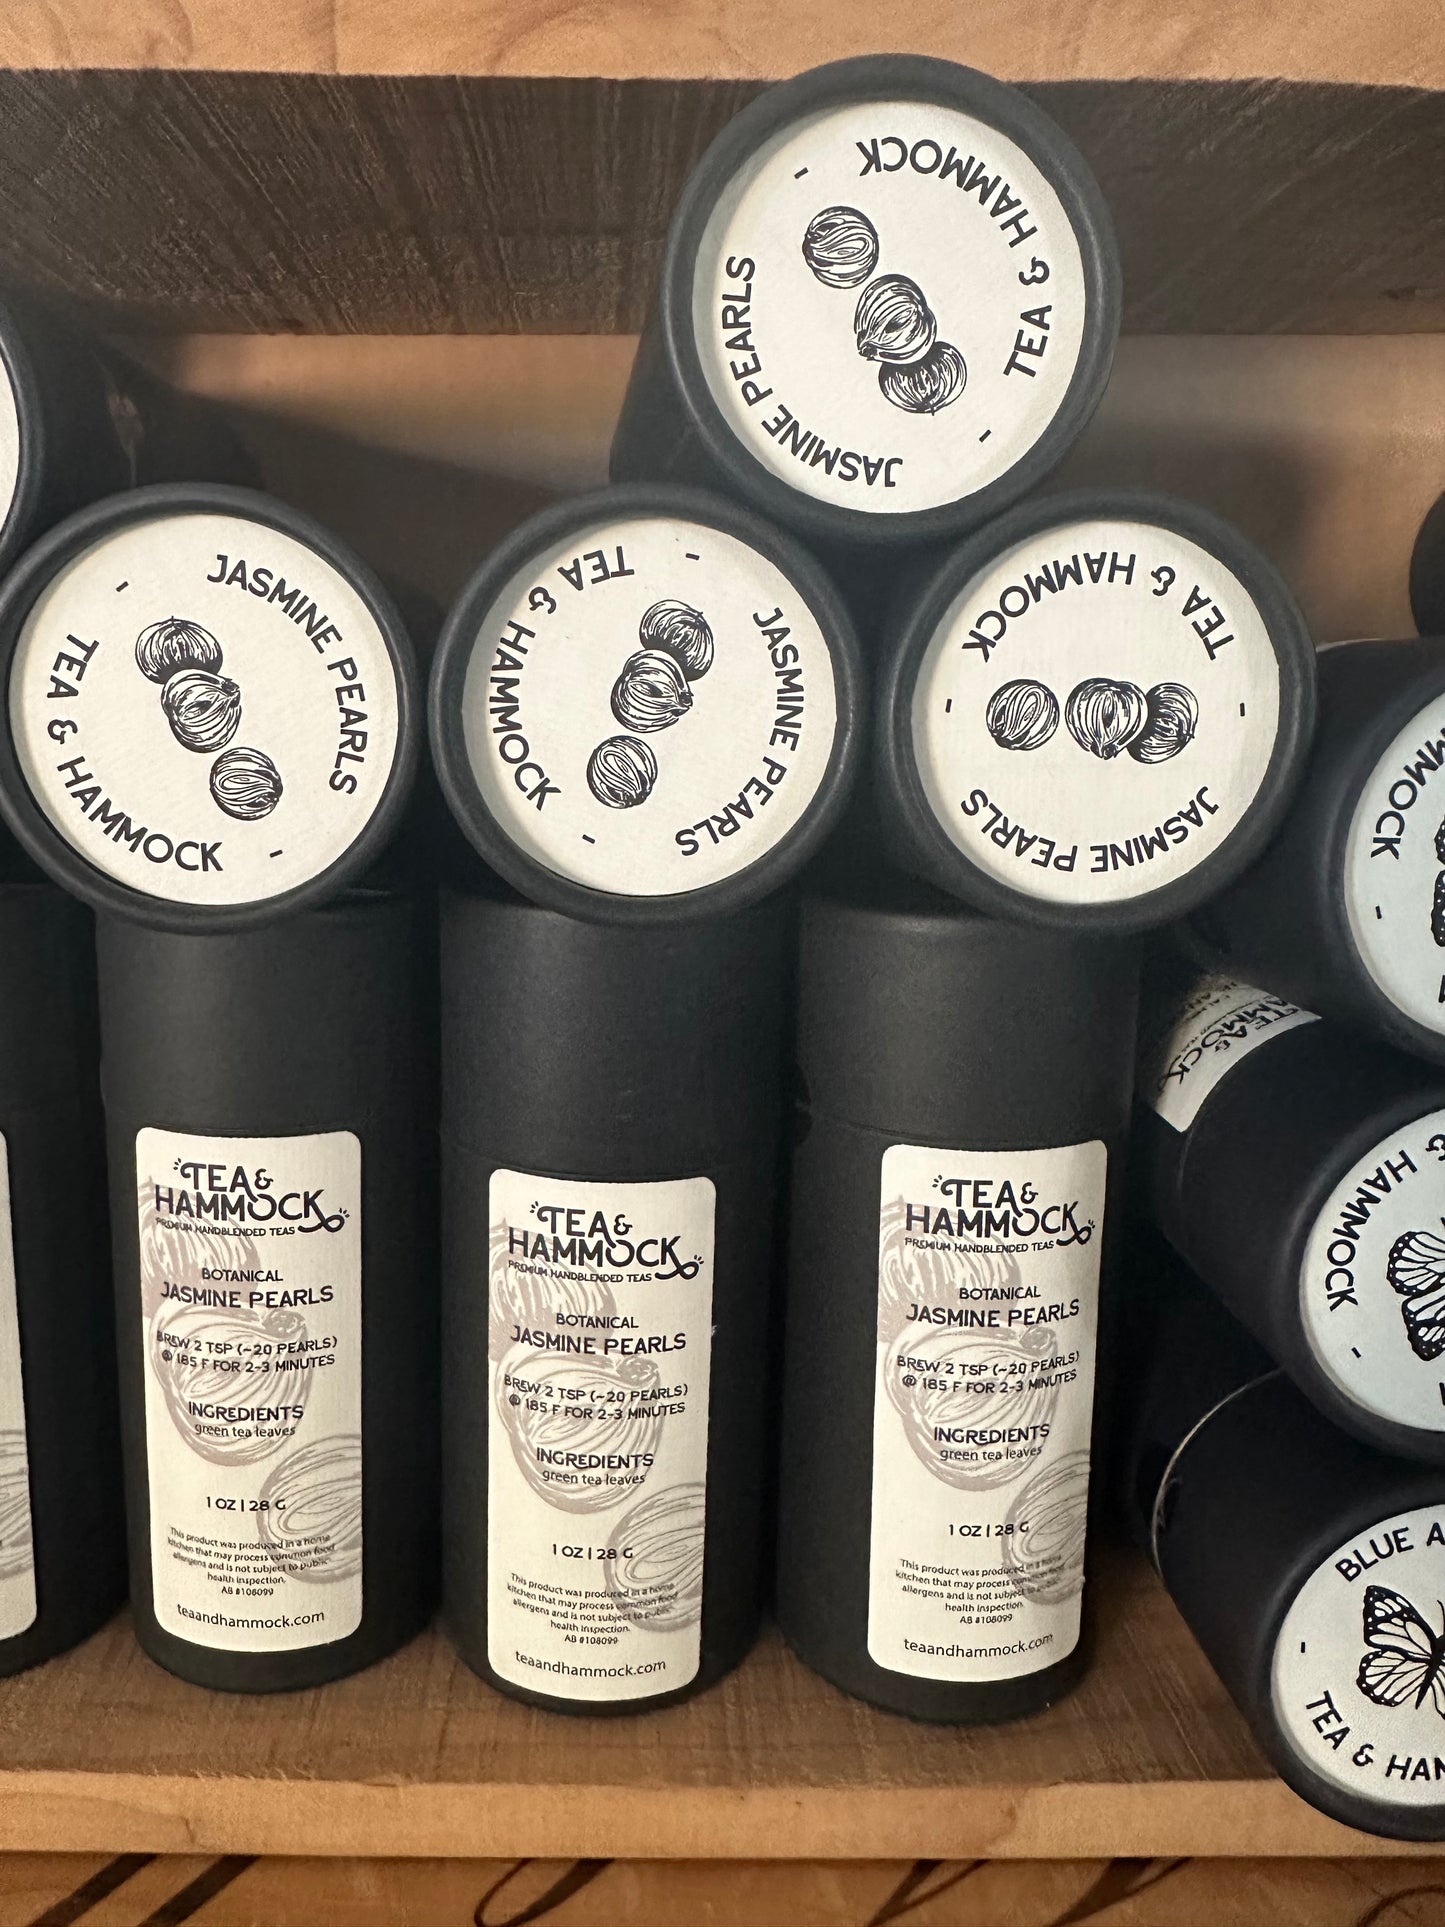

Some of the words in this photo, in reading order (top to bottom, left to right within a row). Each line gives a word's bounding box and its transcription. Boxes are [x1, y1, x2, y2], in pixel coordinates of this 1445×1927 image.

[856, 136, 1038, 248] HAMMOCK
[1019, 257, 1049, 285] &
[722, 256, 774, 406] PEARLS
[1003, 304, 1052, 378] TEA
[761, 404, 902, 487] JASMINE
[557, 545, 635, 590] TEA
[1151, 565, 1176, 596] &
[528, 587, 557, 614] &
[961, 552, 1136, 662] HAMMOCK
[1181, 585, 1234, 660] TEA
[47, 634, 99, 699] TEA
[207, 554, 343, 653] JASMINE
[327, 657, 368, 795] PEARLS
[752, 607, 804, 751] JASMINE
[489, 620, 561, 811] HAMMOCK
[47, 719, 78, 744] &
[57, 756, 223, 872] HAMMOCK
[675, 756, 788, 856] PEARLS
[960, 788, 1078, 872] PEARLS
[1090, 786, 1219, 873] JASMINE
[155, 1185, 345, 1233] HAMMOCK
[156, 1218, 192, 1232] PREMIUM
[195, 1224, 266, 1236] HANDBLENDED
[270, 1227, 295, 1236] TEAS
[906, 1201, 1091, 1245] HAMMOCK
[1326, 1149, 1418, 1312] HAMMOCK
[508, 1227, 699, 1280] HAMMOCK
[904, 1237, 950, 1251] PREMIUM
[955, 1243, 1028, 1254] HANDBLENDED
[1032, 1241, 1054, 1251] TEAS
[202, 1268, 283, 1282] BOTANICAL
[508, 1260, 548, 1276] PREMIUM
[550, 1269, 623, 1283] HANDBLENDED
[627, 1273, 652, 1282] TEAS
[161, 1281, 241, 1308] JASMINE
[250, 1286, 334, 1308] PEARLS
[960, 1286, 1041, 1301] BOTANICAL
[556, 1313, 639, 1329] BOTANICAL
[906, 1303, 1000, 1328] JASMINE
[1008, 1299, 1079, 1327] PEARLS
[157, 1330, 188, 1349] BREW
[194, 1340, 202, 1351] 2
[206, 1342, 232, 1354] TSP
[278, 1336, 338, 1354] PEARLS)
[511, 1325, 596, 1354] JASMINE
[604, 1333, 687, 1355] PEARLS
[177, 1353, 197, 1366] 185
[202, 1359, 208, 1369] F
[214, 1360, 241, 1372] FOR
[246, 1362, 270, 1372] 2-3
[276, 1355, 335, 1372] MINUTES
[897, 1355, 940, 1373] BREW
[945, 1363, 954, 1374] 2
[959, 1364, 988, 1374] TSP
[1031, 1351, 1079, 1372] PEARLS)
[504, 1374, 541, 1394] BREW
[546, 1386, 553, 1398] 2
[558, 1388, 585, 1400] TSP
[631, 1384, 688, 1401] PEARLS)
[923, 1378, 946, 1391] 185
[954, 1382, 960, 1392] F
[966, 1382, 995, 1393] FOR
[1000, 1381, 1023, 1393] 2-3
[1029, 1369, 1077, 1390] MINUTES
[188, 1401, 304, 1422] INGREDIENTS
[526, 1400, 547, 1413] 185
[553, 1405, 560, 1415] F
[565, 1406, 592, 1419] FOR
[598, 1409, 622, 1420] 2-3
[628, 1402, 685, 1419] MINUTES
[195, 1423, 229, 1437] green
[232, 1426, 253, 1438] tea
[254, 1425, 296, 1438] leaves
[934, 1424, 1049, 1445] INGREDIENTS
[537, 1447, 654, 1469] INGREDIENTS
[940, 1449, 978, 1461] green
[982, 1450, 1002, 1460] tea
[1006, 1446, 1042, 1459] leaves
[542, 1469, 578, 1484] green
[582, 1473, 602, 1485] tea
[606, 1473, 645, 1485] leaves
[207, 1497, 211, 1508] 1
[216, 1498, 236, 1510] OZ
[250, 1500, 269, 1511] 28
[276, 1499, 286, 1510] G
[949, 1524, 953, 1535] 1
[960, 1525, 981, 1537] OZ
[995, 1524, 1014, 1536] 28
[1019, 1521, 1029, 1533] G
[552, 1544, 557, 1555] 1
[562, 1546, 583, 1558] OZ
[597, 1548, 617, 1559] 28
[623, 1548, 633, 1558] G
[1335, 1527, 1414, 1582] BLUE
[896, 1570, 930, 1584] kitchen
[932, 1577, 951, 1587] that
[954, 1580, 974, 1590] may
[976, 1579, 1009, 1590] process
[901, 1559, 919, 1571] This
[922, 1565, 959, 1576] product
[982, 1566, 1024, 1577] produced
[507, 1583, 536, 1600] kitchen
[538, 1594, 556, 1605] that
[558, 1598, 577, 1610] may
[579, 1601, 614, 1611] process
[511, 1573, 526, 1586] This
[529, 1580, 563, 1595] product
[565, 1589, 582, 1598] was
[585, 1589, 629, 1598] produced
[177, 1604, 325, 1628] teaandhammock.com
[513, 1598, 549, 1616] allergens
[552, 1610, 568, 1619] and
[571, 1611, 577, 1620] is
[580, 1613, 595, 1621] not
[598, 1614, 630, 1623] subject
[945, 1602, 974, 1612] health
[551, 1620, 578, 1632] health
[960, 1616, 972, 1624] AB
[564, 1635, 577, 1643] AB
[904, 1634, 1054, 1658] teaandhammock.com
[515, 1651, 666, 1677] teaandhammock.com
[1306, 1690, 1350, 1750] TEA
[1352, 1743, 1374, 1767] &
